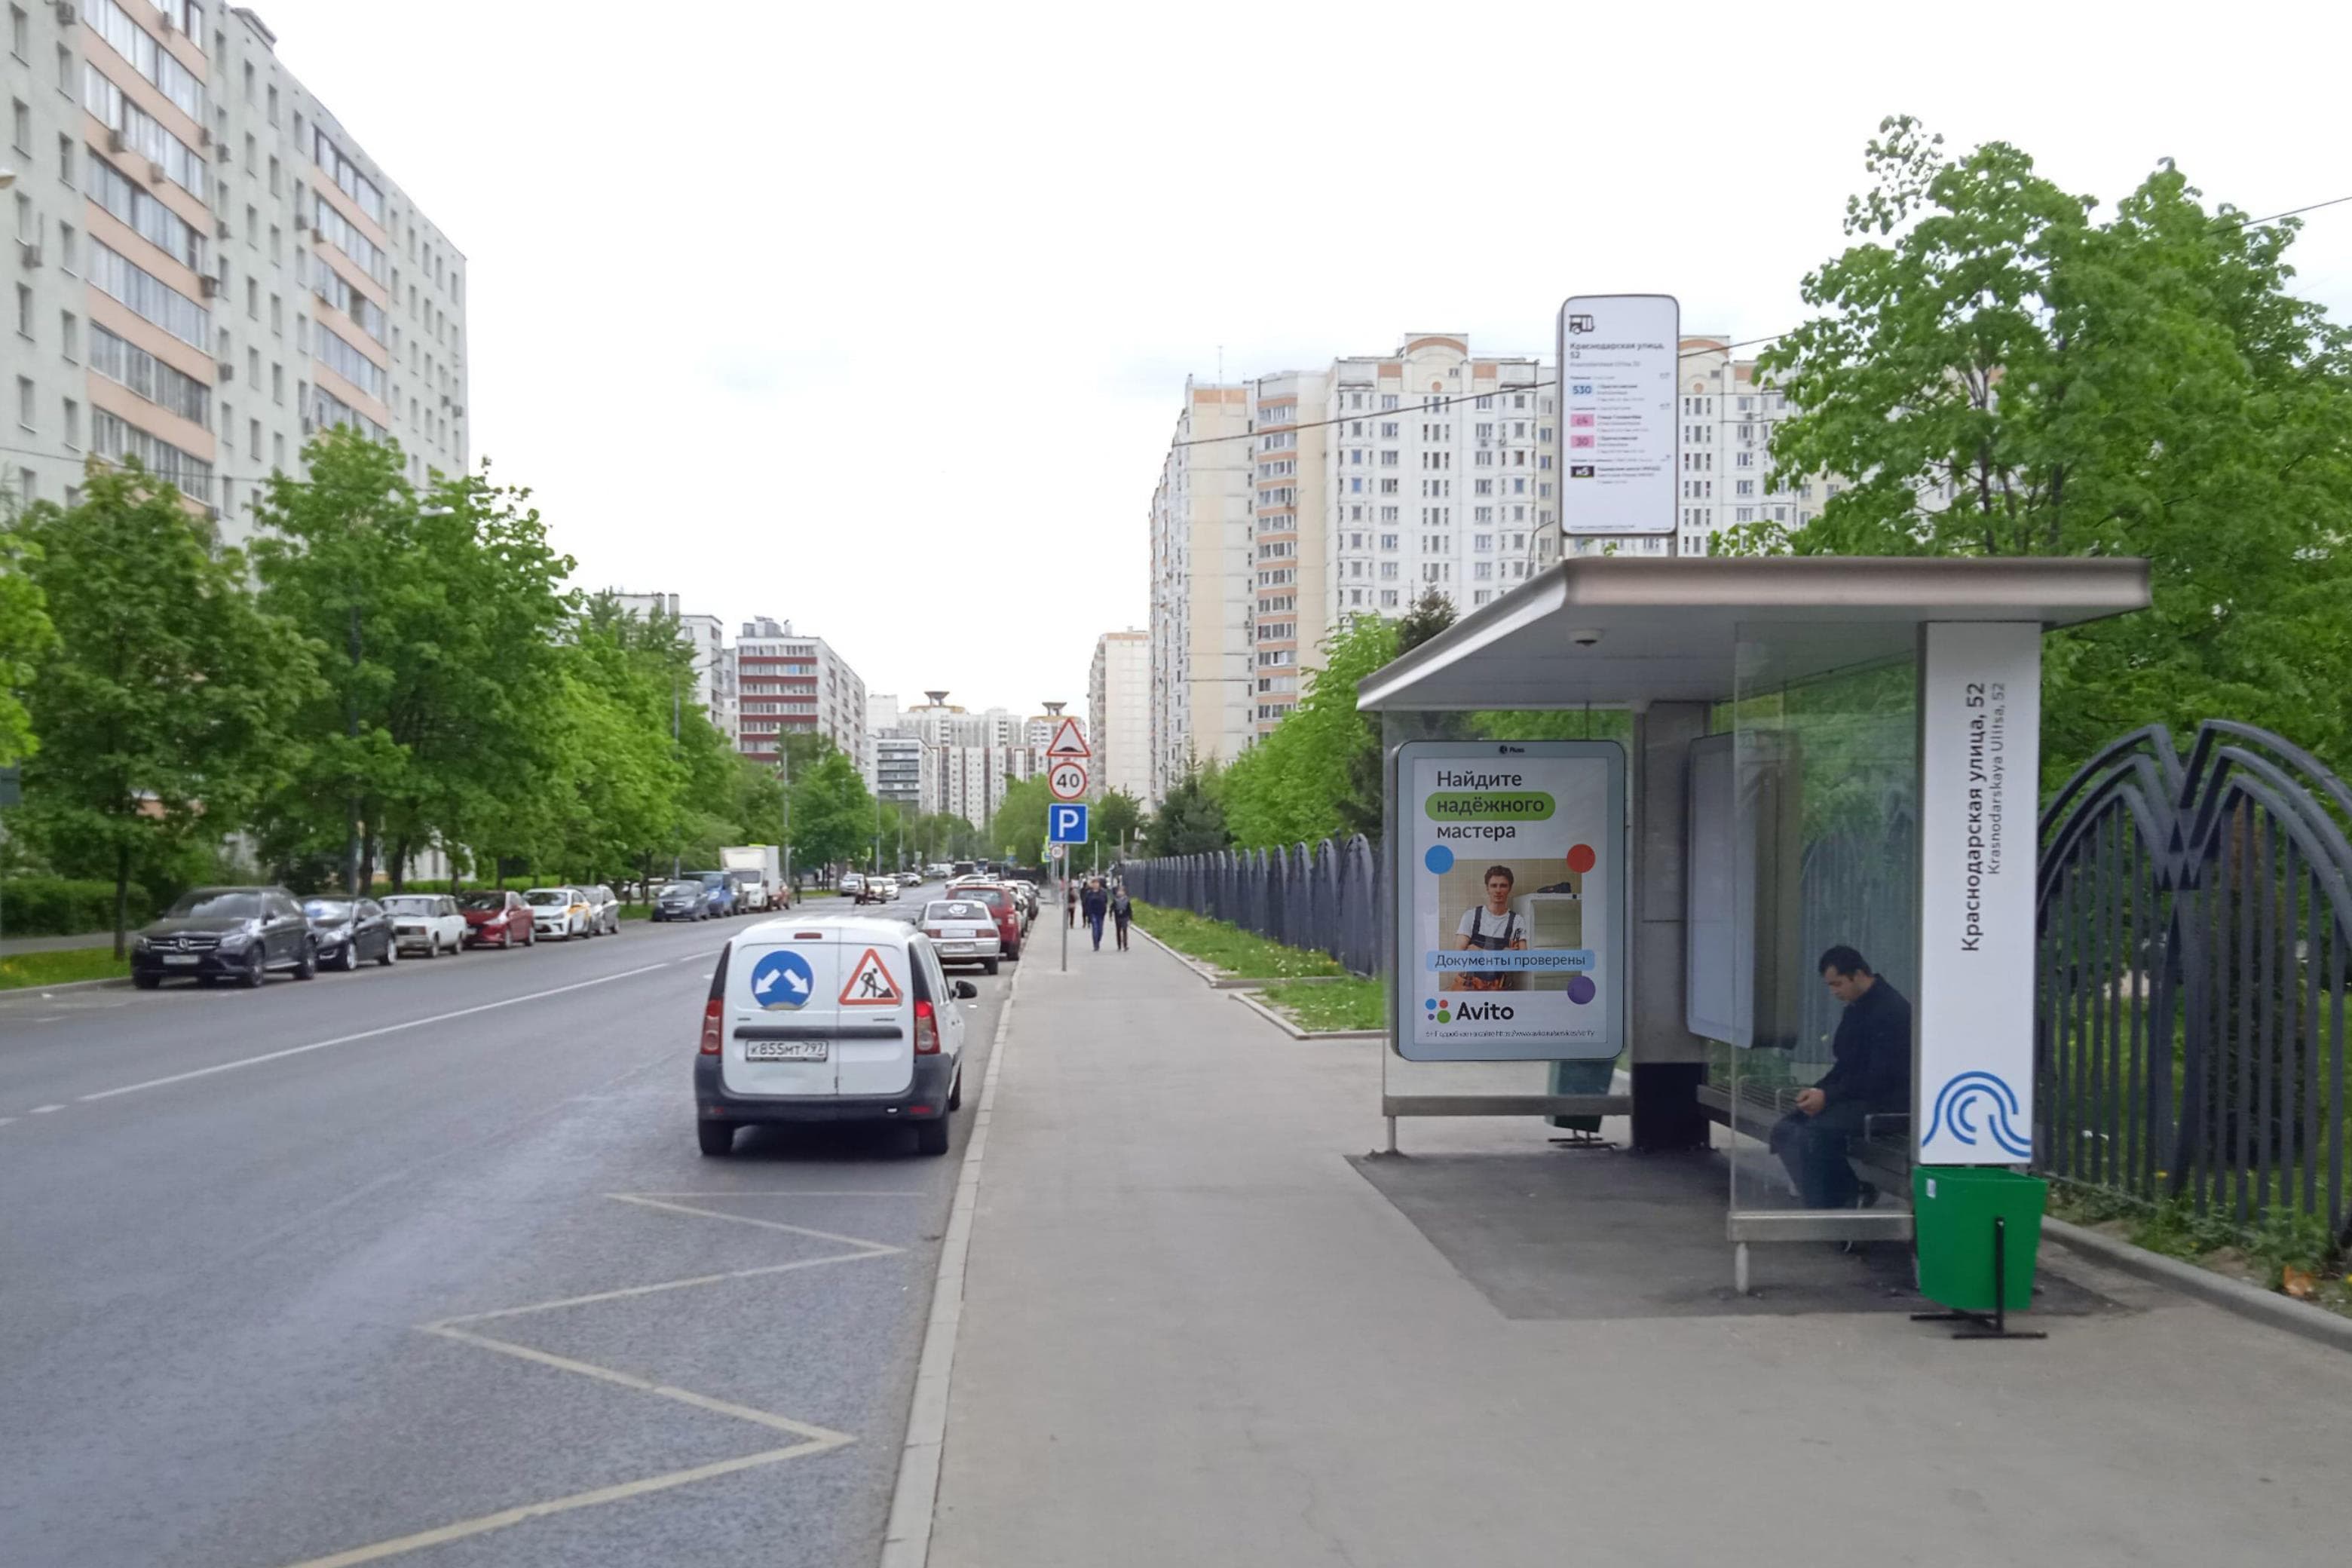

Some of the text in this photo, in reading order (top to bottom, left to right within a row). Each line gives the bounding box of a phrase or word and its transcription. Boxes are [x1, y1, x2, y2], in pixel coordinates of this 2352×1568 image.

[1056, 773, 1080, 789] 40
[1437, 770, 1522, 790] Найдите
[1988, 683, 2005, 874] Krasnodarskaya Ulitsa, 52
[1437, 797, 1545, 816] надёжного
[1058, 809, 1080, 838] P
[1962, 683, 1988, 951] Краснодарская улица, 52
[1437, 825, 1516, 841] мастера
[1435, 954, 1586, 969] Документы проверены
[1456, 1001, 1514, 1021] Avito
